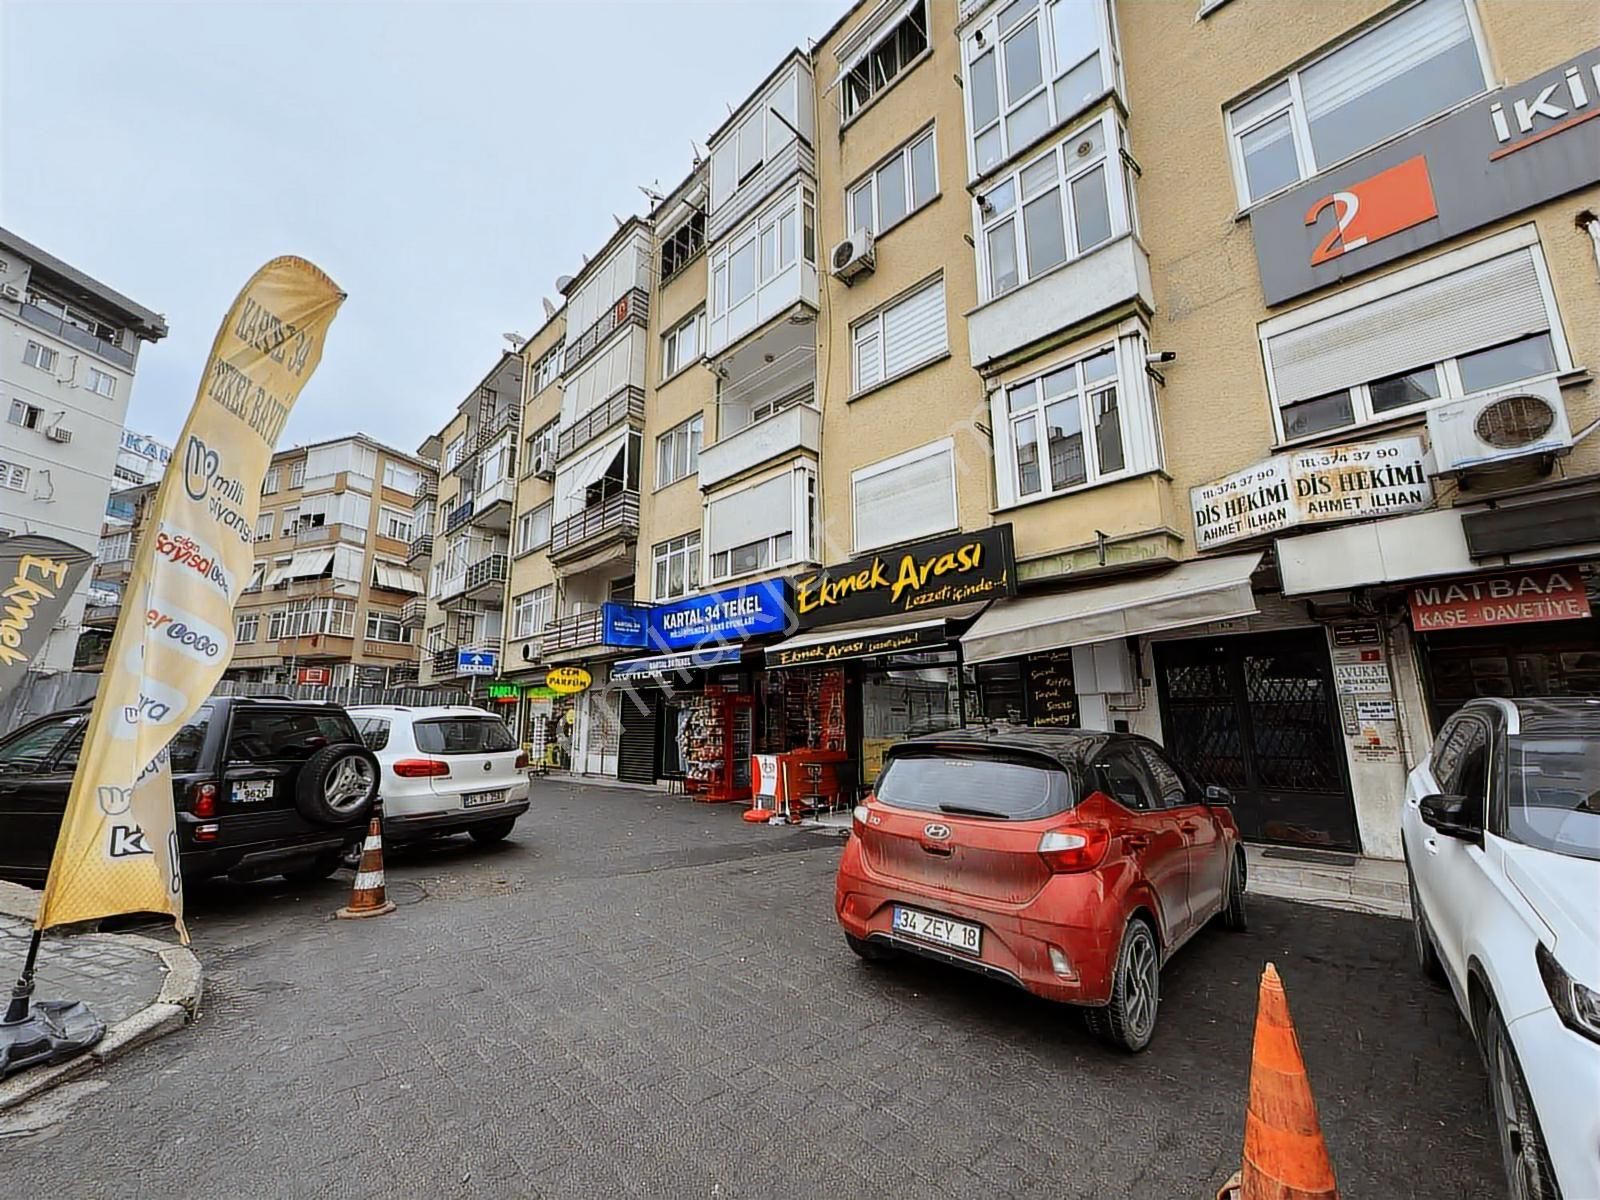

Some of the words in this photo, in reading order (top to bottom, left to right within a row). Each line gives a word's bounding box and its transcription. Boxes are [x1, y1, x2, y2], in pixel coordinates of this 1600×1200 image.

[1353, 451, 1371, 462] 37
[1376, 447, 1399, 458] 90
[212, 475, 245, 506] milli
[1239, 474, 1254, 488] 37
[1256, 468, 1275, 481] 90
[1340, 460, 1426, 492] HEKİMİ
[1225, 478, 1290, 518] HEKİMİ
[1307, 496, 1363, 514] AHMET
[1370, 490, 1423, 508] İLHAN
[209, 496, 254, 543] iyang
[1203, 518, 1242, 542] AHMET
[1247, 507, 1288, 529] İLHAN
[797, 557, 891, 614] Ekmek
[890, 542, 981, 604] Arası
[1415, 573, 1574, 606] MATBAA
[663, 607, 705, 631] KARTAL
[704, 605, 721, 622] 34
[723, 595, 763, 619] TEKEL
[1483, 597, 1582, 622] DAVETİYE
[780, 645, 825, 665] Ekmek
[548, 675, 588, 688] PARFÜM
[560, 668, 580, 676] CEM
[1338, 664, 1386, 678] AVUKAT
[900, 911, 917, 930] 34
[922, 916, 955, 940] ZEY
[962, 927, 977, 947] 18
